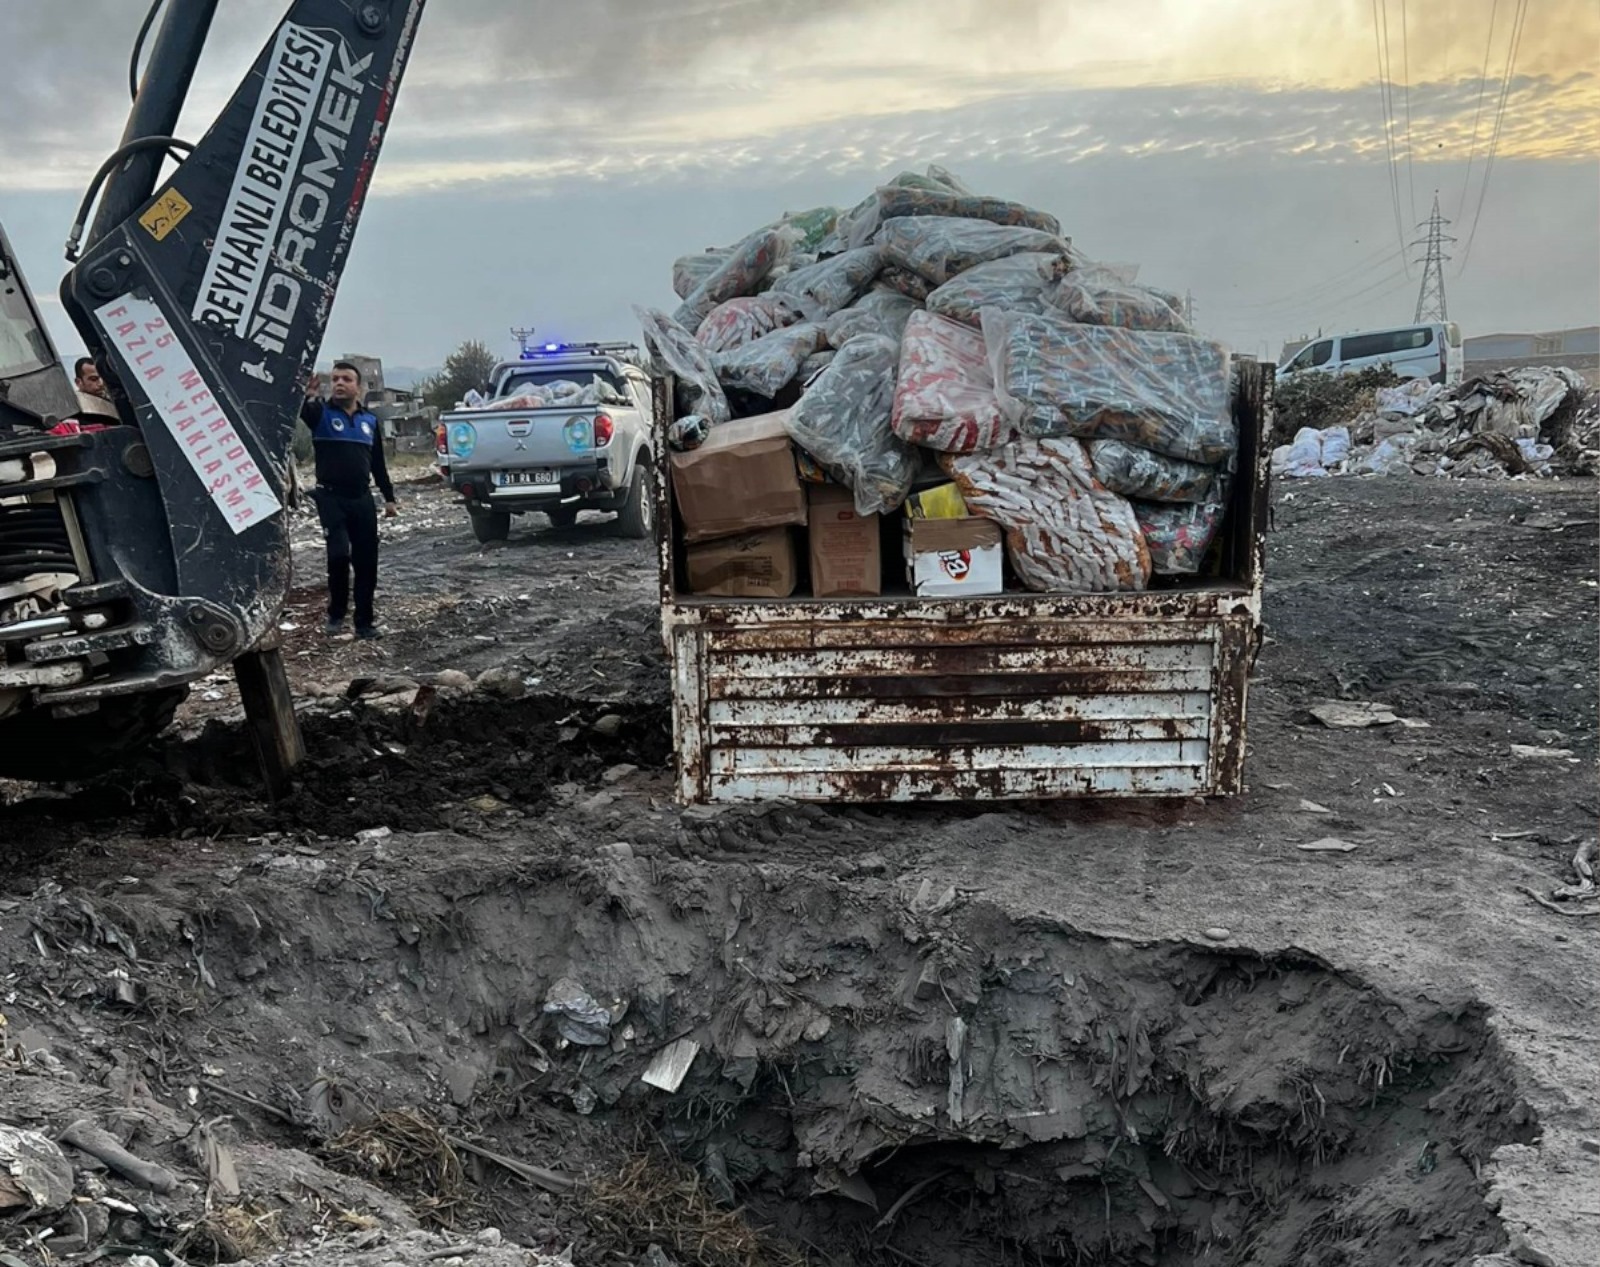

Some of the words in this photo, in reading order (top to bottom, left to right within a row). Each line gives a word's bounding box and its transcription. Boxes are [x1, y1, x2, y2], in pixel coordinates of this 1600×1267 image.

[202, 186, 277, 336] REYHANLI
[246, 27, 325, 192] BELEDİYESİ
[107, 305, 164, 382] FAZLA
[170, 399, 255, 524] YAKLAŞMA
[144, 317, 175, 349] 25
[178, 369, 264, 490] METREDEN
[504, 473, 515, 484] 31
[519, 472, 531, 484] RA
